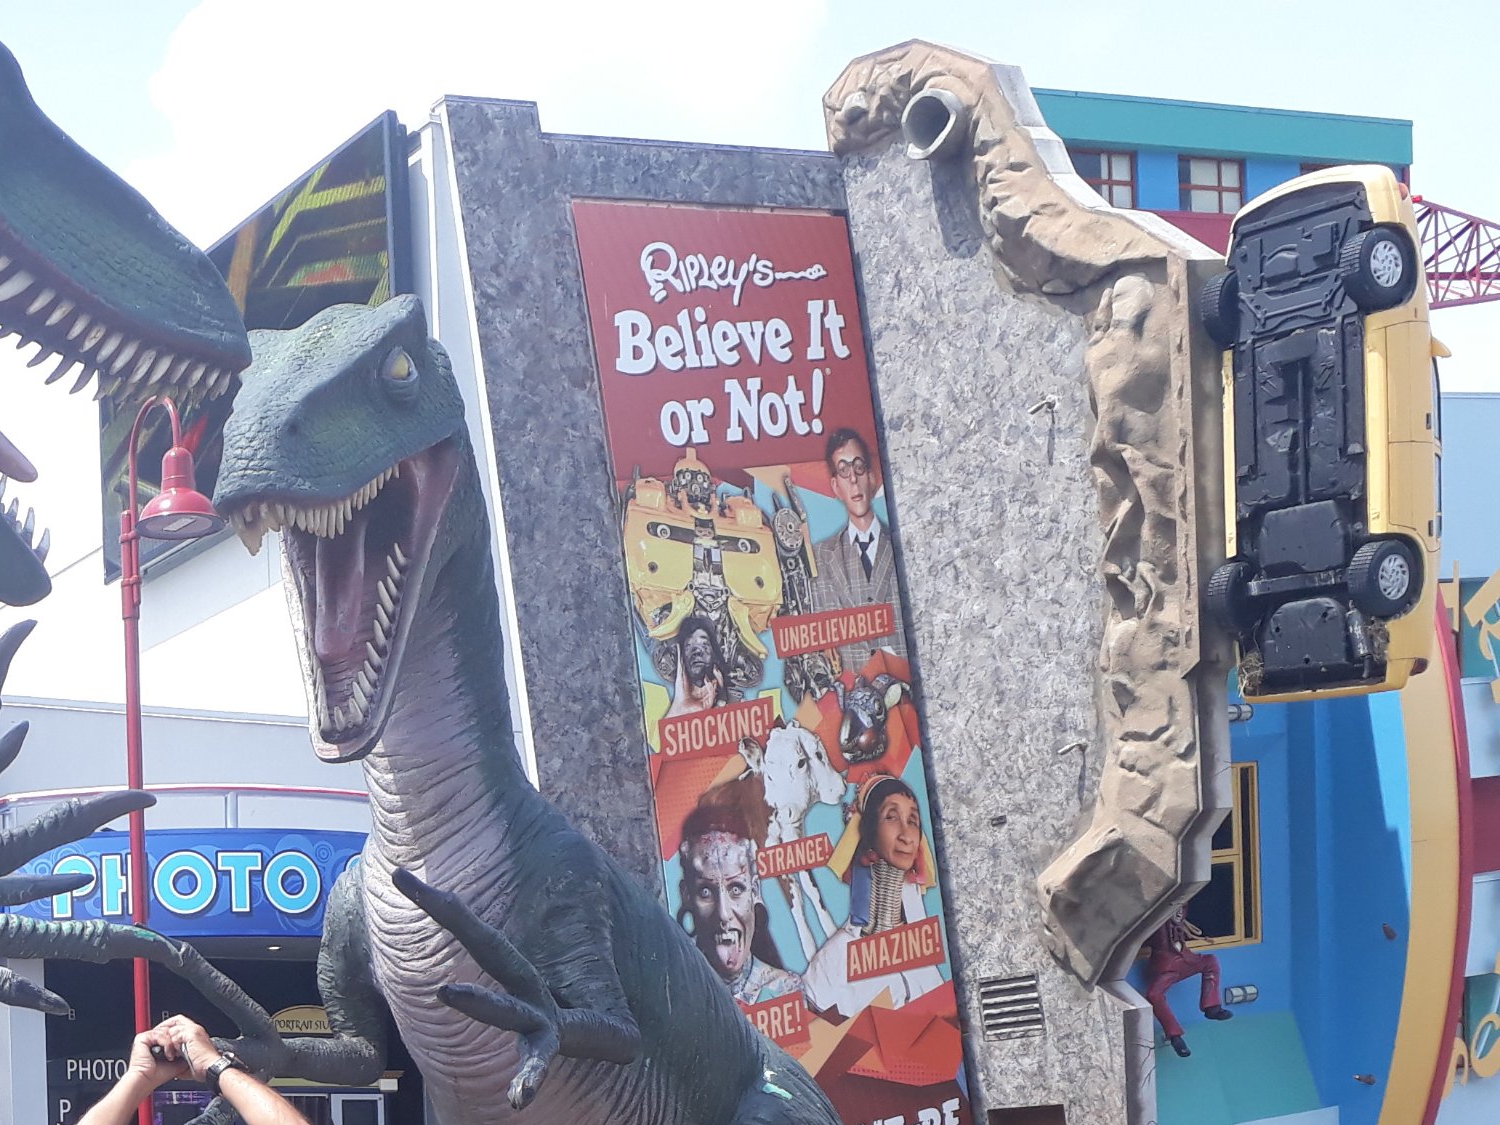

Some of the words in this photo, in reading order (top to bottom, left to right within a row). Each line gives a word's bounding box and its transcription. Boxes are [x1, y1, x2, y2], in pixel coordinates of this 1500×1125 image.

[614, 306, 793, 375] Believe
[806, 299, 851, 361] It
[659, 396, 715, 447] or
[725, 367, 825, 442] Not!
[779, 608, 889, 652] UNBELIEVABLE!
[664, 704, 771, 756] SHOCKING!
[756, 836, 830, 877] STRANGE!
[52, 851, 321, 919] PHOTO
[849, 922, 941, 977] AMAZING!
[746, 1000, 802, 1039] RRE!
